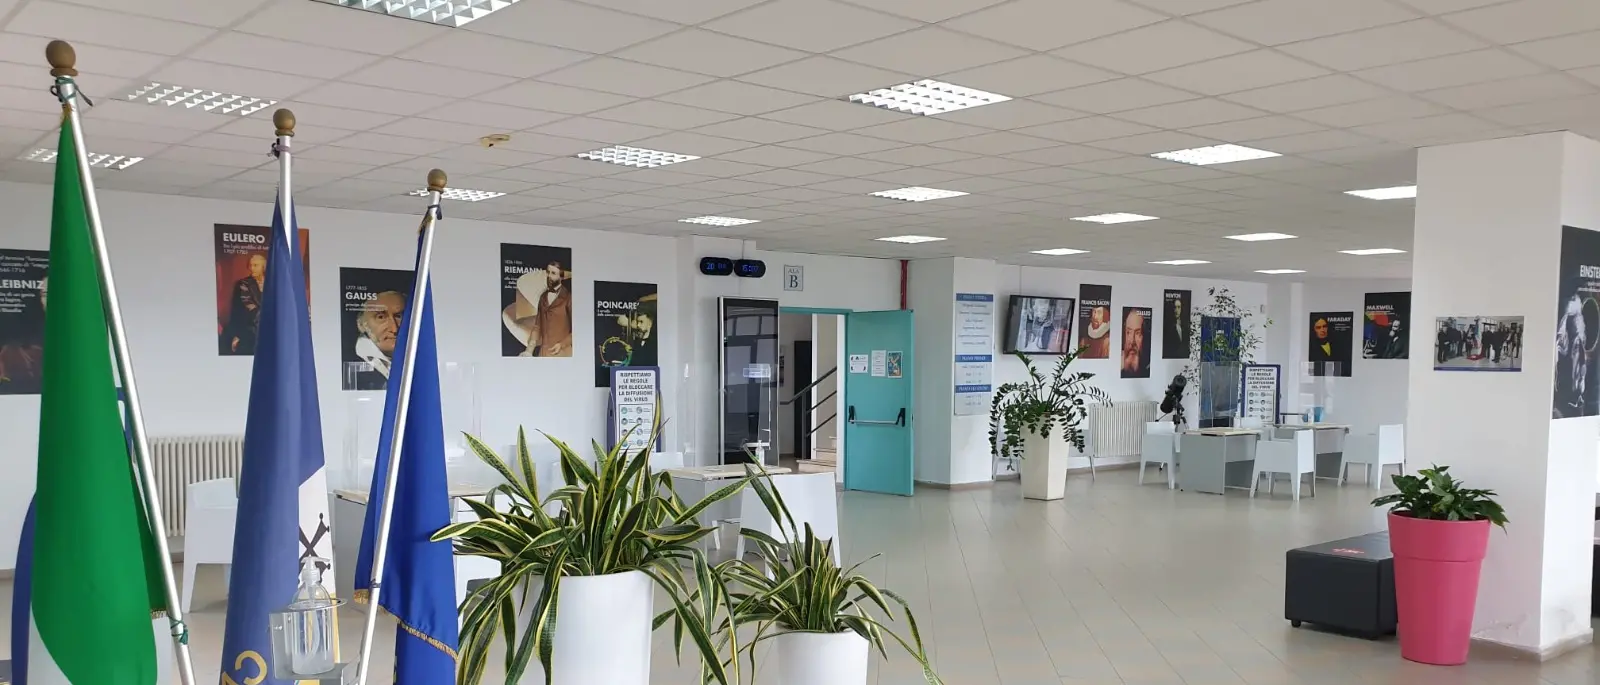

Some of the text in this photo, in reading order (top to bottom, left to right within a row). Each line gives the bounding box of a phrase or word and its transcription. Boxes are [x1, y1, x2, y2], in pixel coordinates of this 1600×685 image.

[223, 232, 266, 244] EULERO
[1580, 264, 1600, 279] EINSTE
[789, 274, 798, 288] B
[345, 291, 378, 301] GAUSS
[597, 300, 640, 310] POINCARE'
